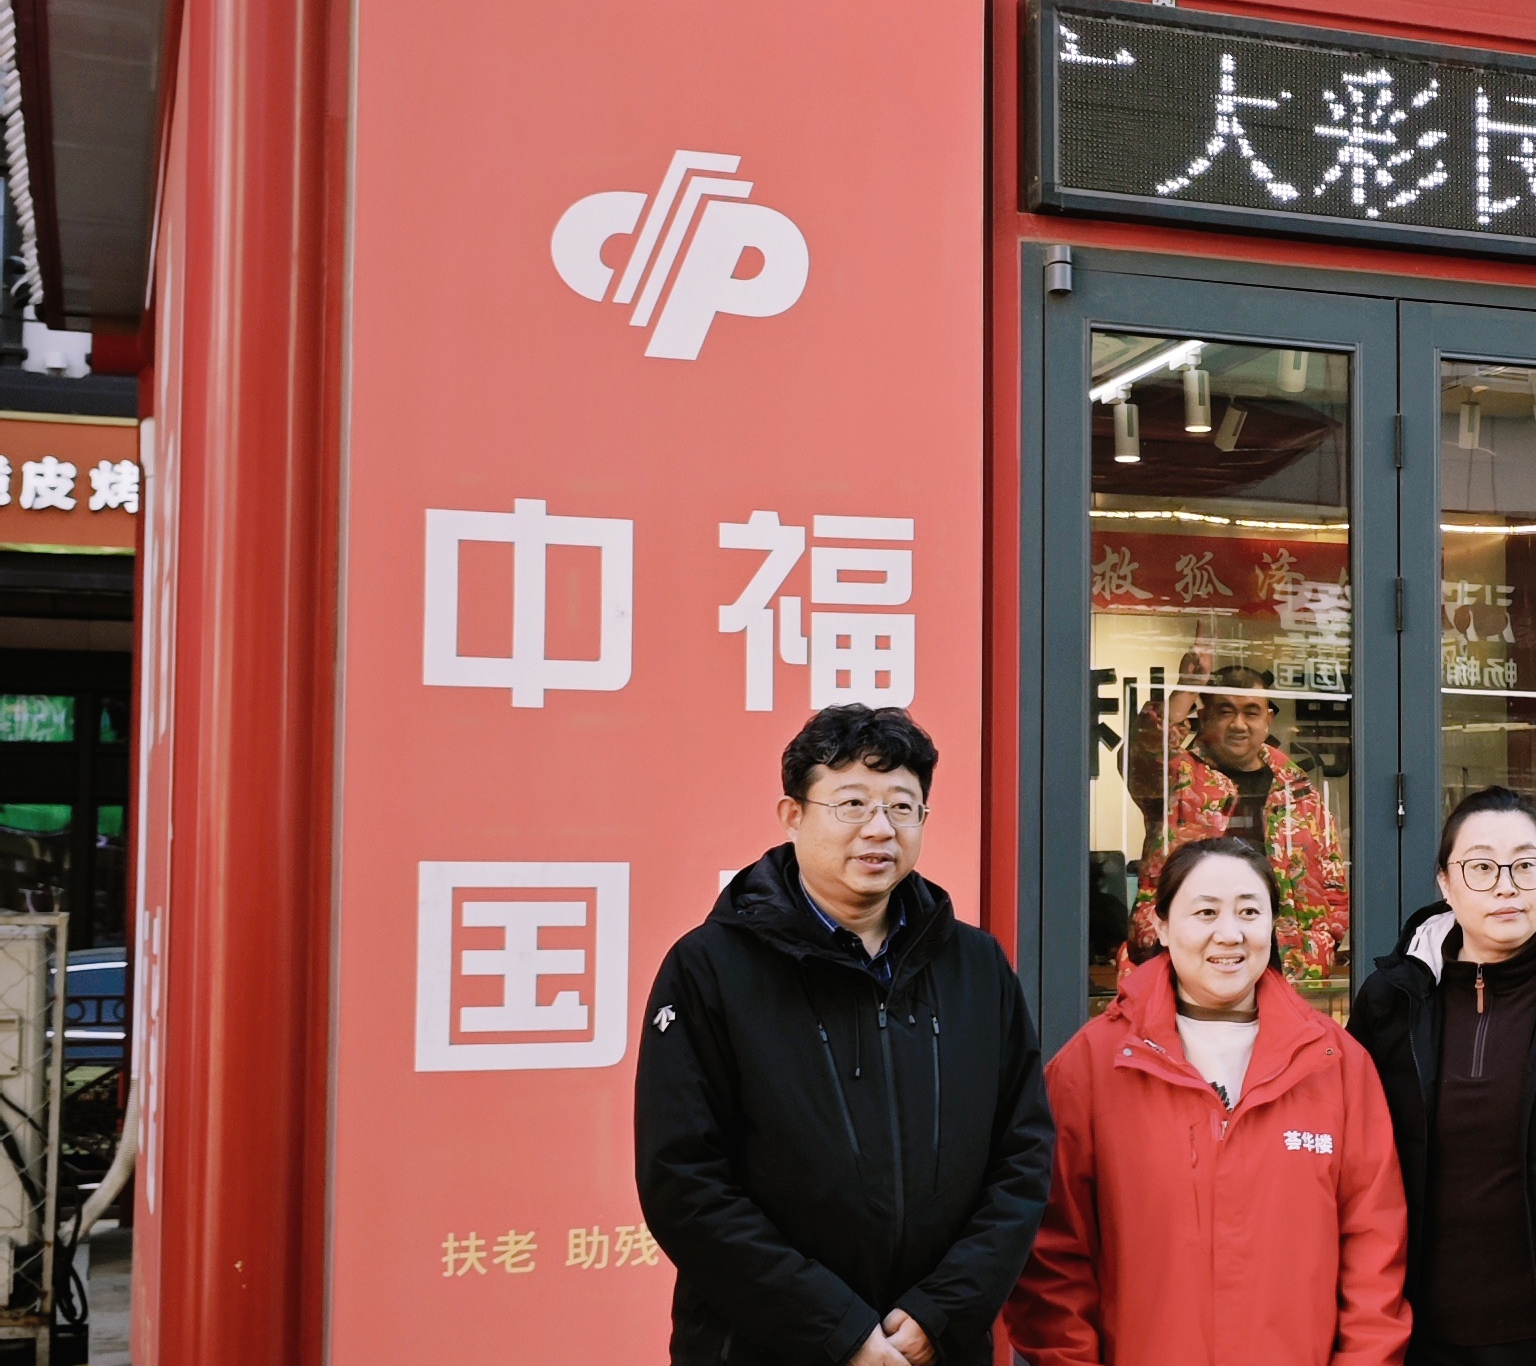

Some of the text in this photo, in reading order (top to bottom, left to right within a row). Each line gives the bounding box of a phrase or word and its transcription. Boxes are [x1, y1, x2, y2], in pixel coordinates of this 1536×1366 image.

[1092, 545, 1349, 601] 救孤济
[441, 1222, 659, 1277] 扶老 助残
